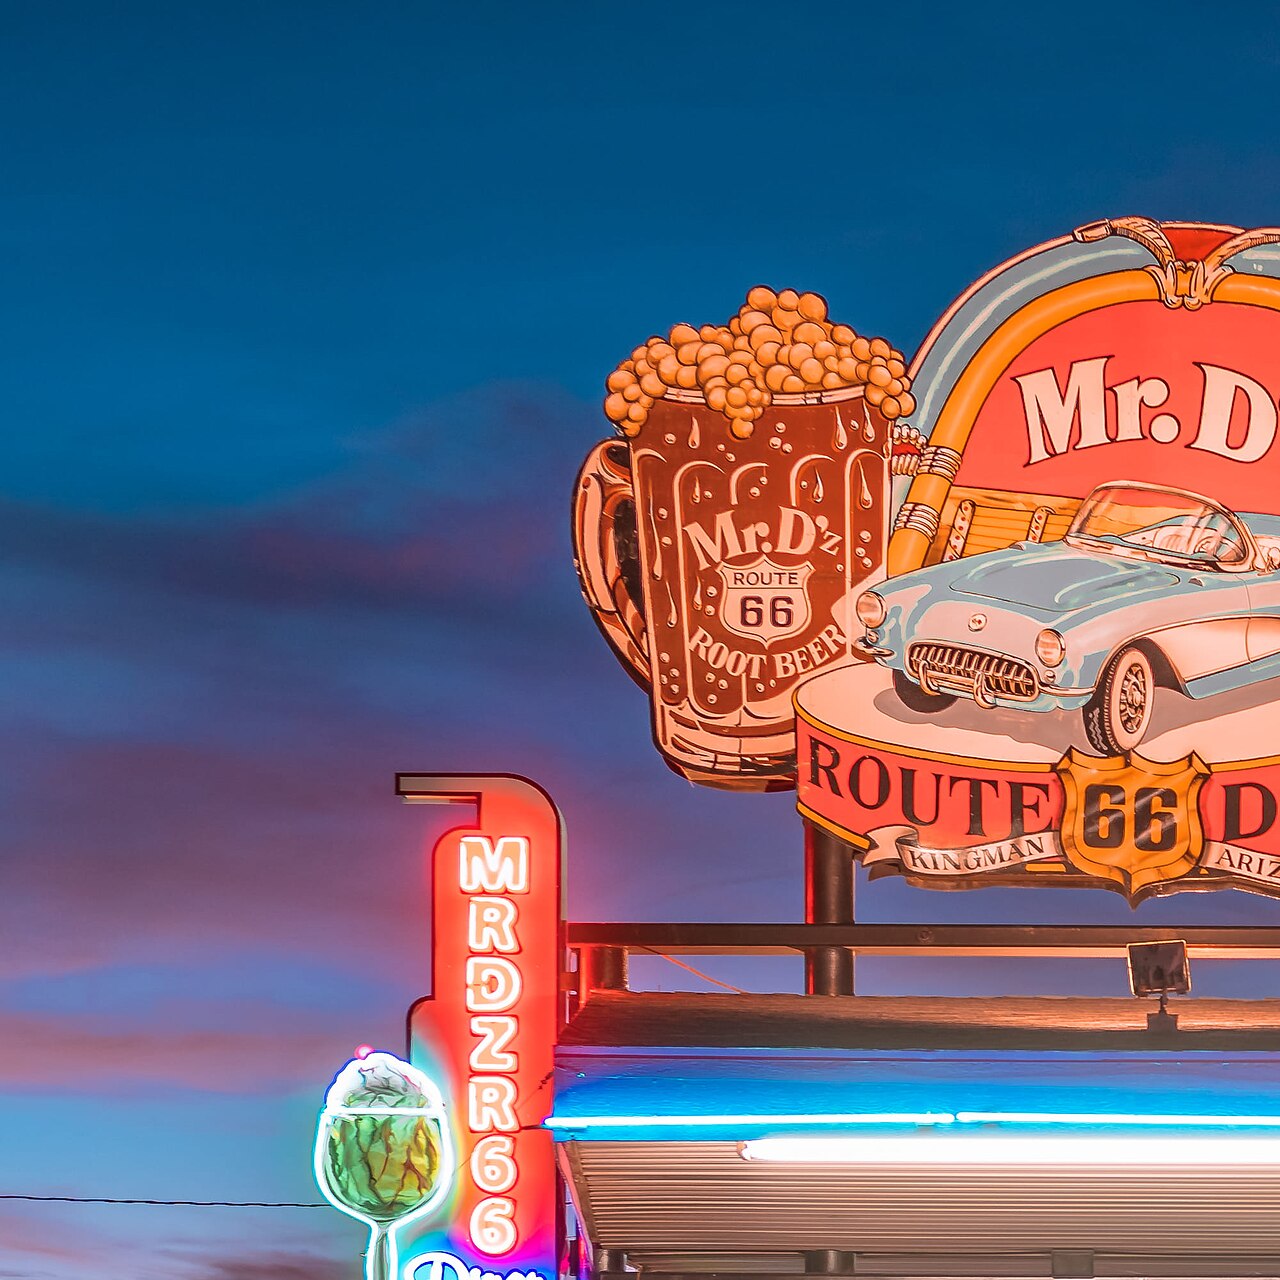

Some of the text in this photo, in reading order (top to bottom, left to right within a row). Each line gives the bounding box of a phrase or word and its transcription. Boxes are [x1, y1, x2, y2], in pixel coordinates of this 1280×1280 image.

[1010, 355, 1181, 467] Mr.
[683, 509, 773, 571] Mr.
[733, 571, 798, 586] ROUTE
[740, 595, 794, 627] 66
[689, 624, 847, 679] ROOT BEER
[808, 734, 1053, 839] ROUTE
[1083, 783, 1178, 851] 66
[911, 836, 1045, 871] KINGMAN
